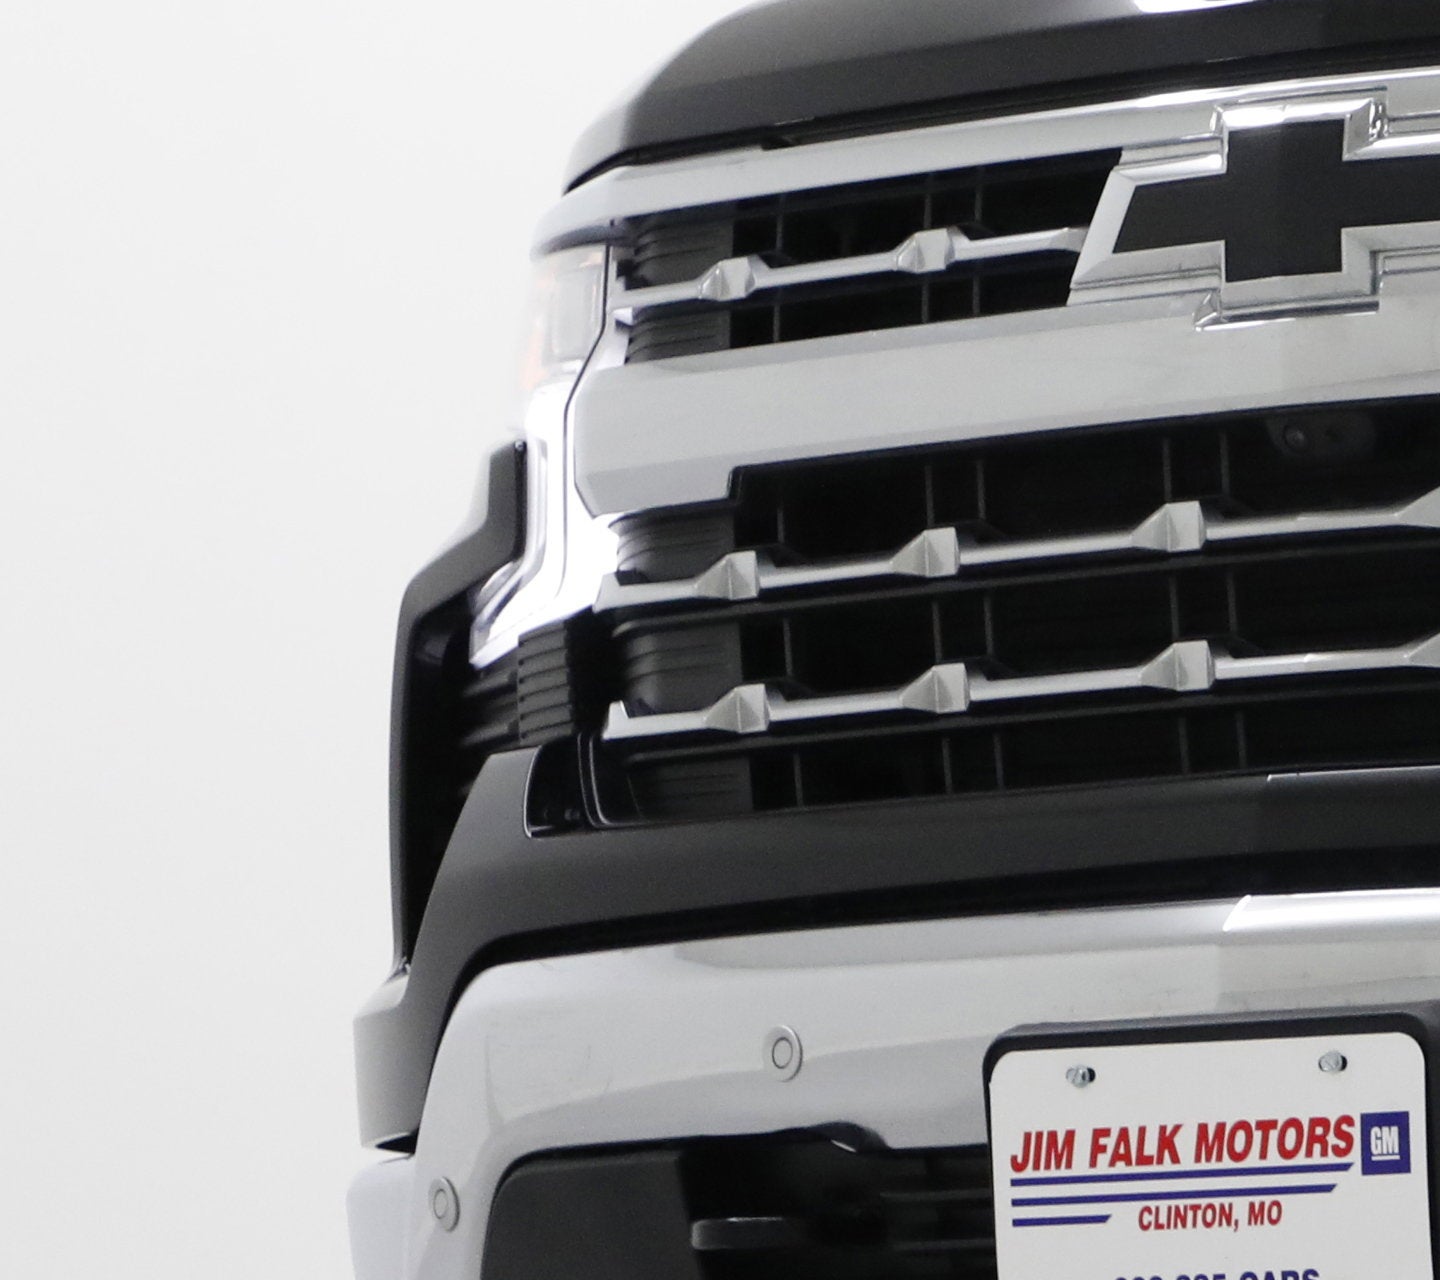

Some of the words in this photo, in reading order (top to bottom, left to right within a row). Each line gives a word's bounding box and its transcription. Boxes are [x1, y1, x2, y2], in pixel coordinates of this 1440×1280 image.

[1010, 1130, 1076, 1173] JIM
[1088, 1123, 1184, 1168] FALK
[1194, 1114, 1355, 1164] MOTORS
[1368, 1125, 1401, 1159] GM
[1138, 1203, 1240, 1233] CLINTON,
[1248, 1200, 1283, 1226] MO
